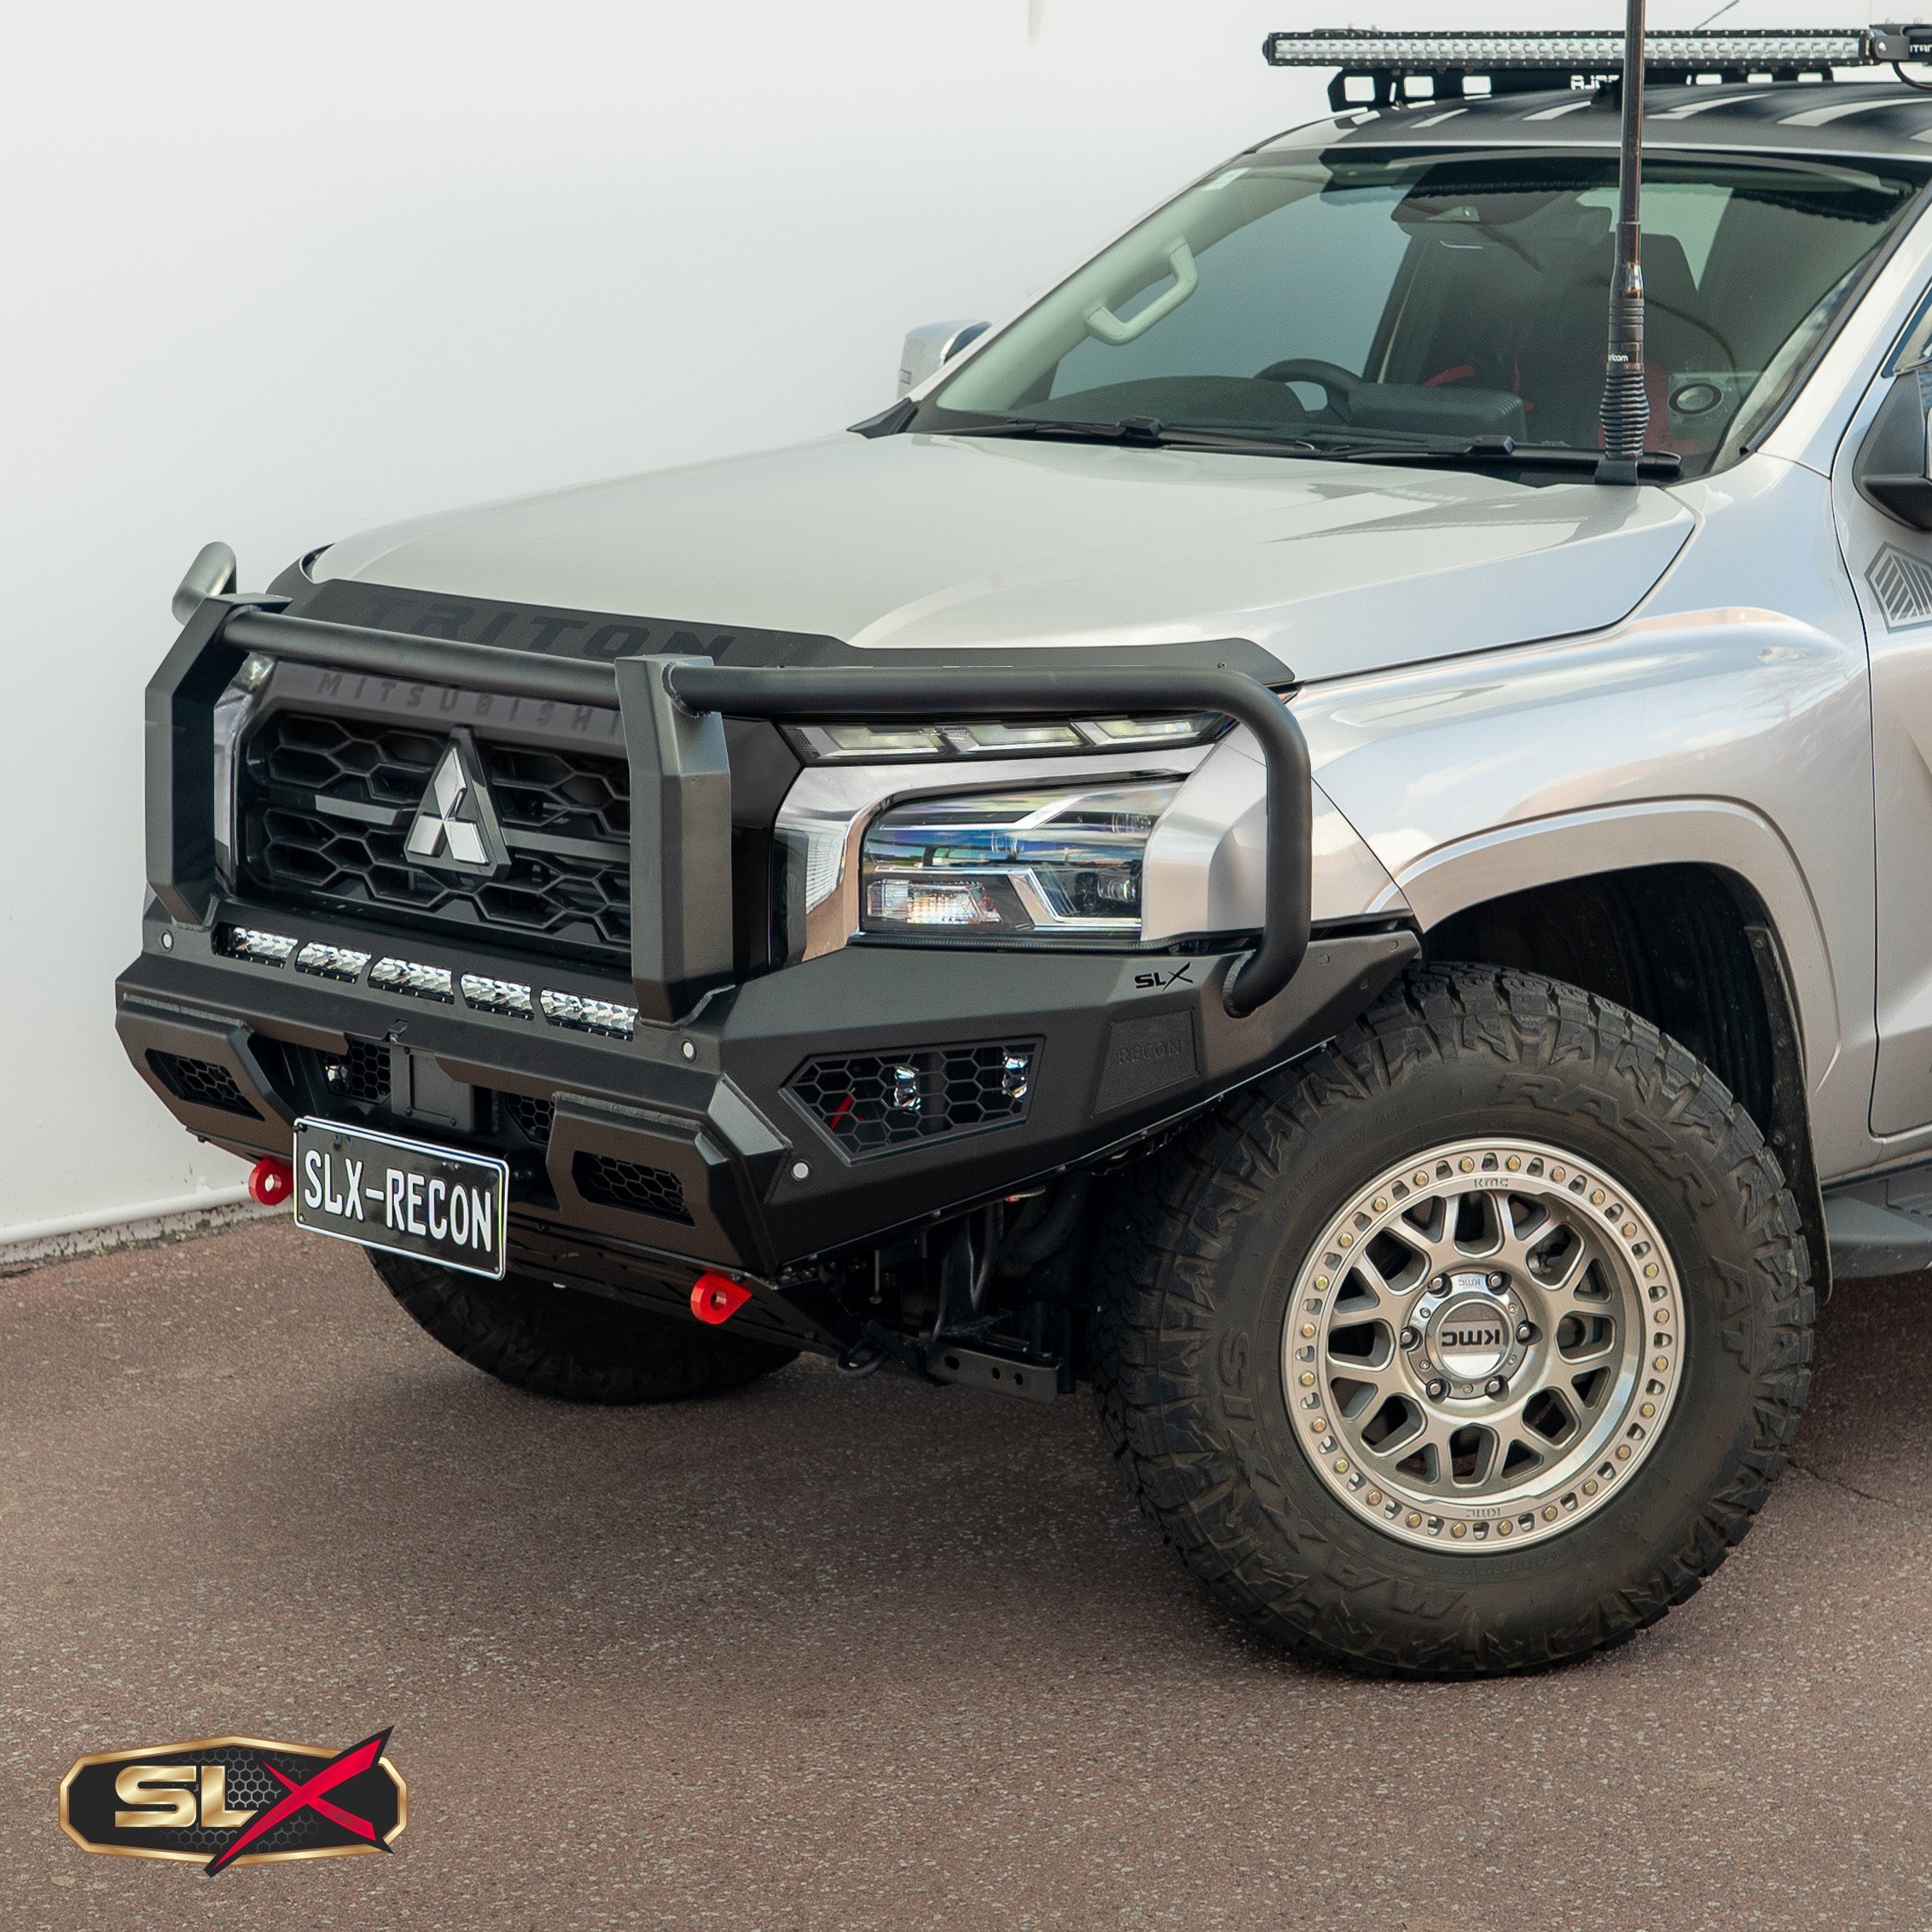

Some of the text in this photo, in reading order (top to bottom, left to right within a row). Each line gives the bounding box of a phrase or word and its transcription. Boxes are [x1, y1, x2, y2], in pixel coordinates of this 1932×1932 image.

[368, 595, 736, 666] TRITON
[316, 670, 620, 736] MITSUBISHI
[1134, 961, 1193, 992] SLX
[1117, 1039, 1181, 1065] RECON
[304, 1150, 492, 1252] SLX-RECON
